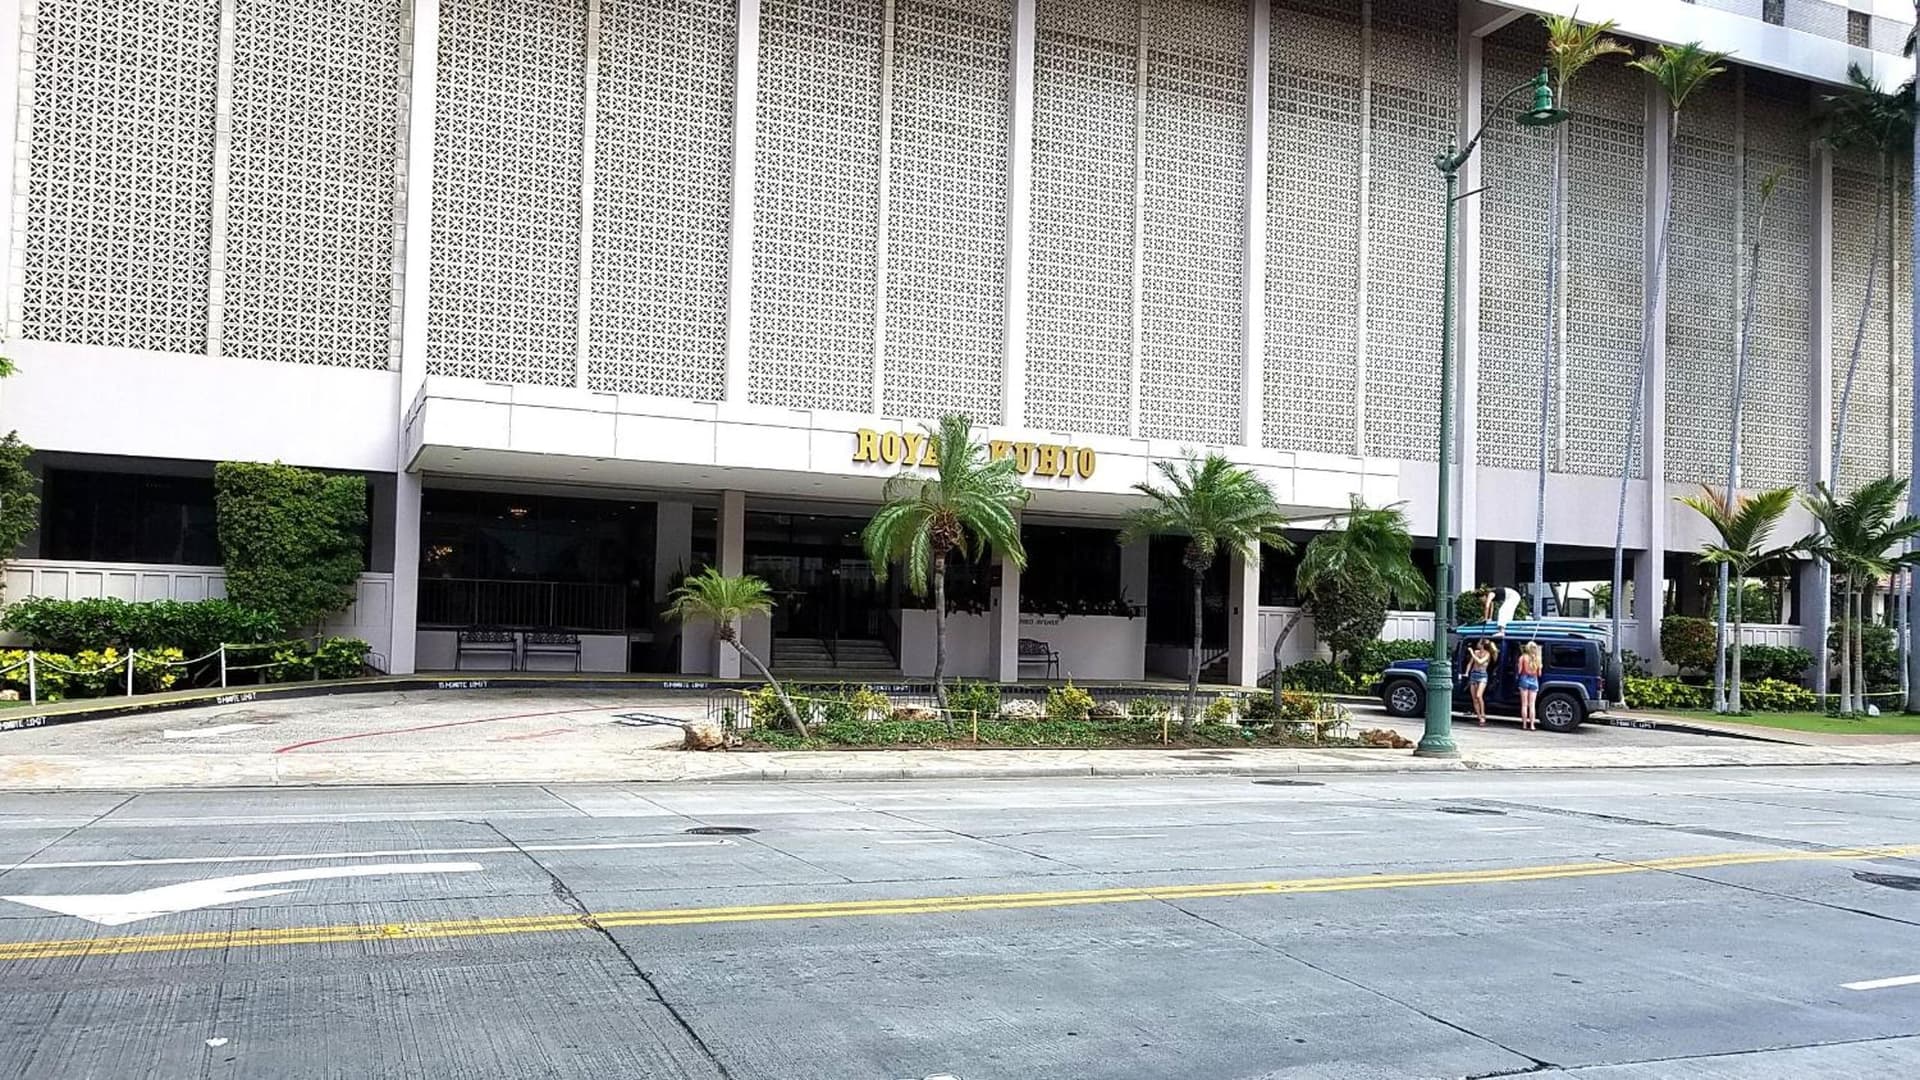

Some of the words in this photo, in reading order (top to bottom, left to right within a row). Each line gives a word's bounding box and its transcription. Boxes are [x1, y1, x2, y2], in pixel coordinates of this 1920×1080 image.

[853, 428, 939, 467] ROYA
[988, 439, 1097, 479] KUHIO
[469, 680, 488, 688] LIMIT
[26, 716, 47, 727] LIMIT
